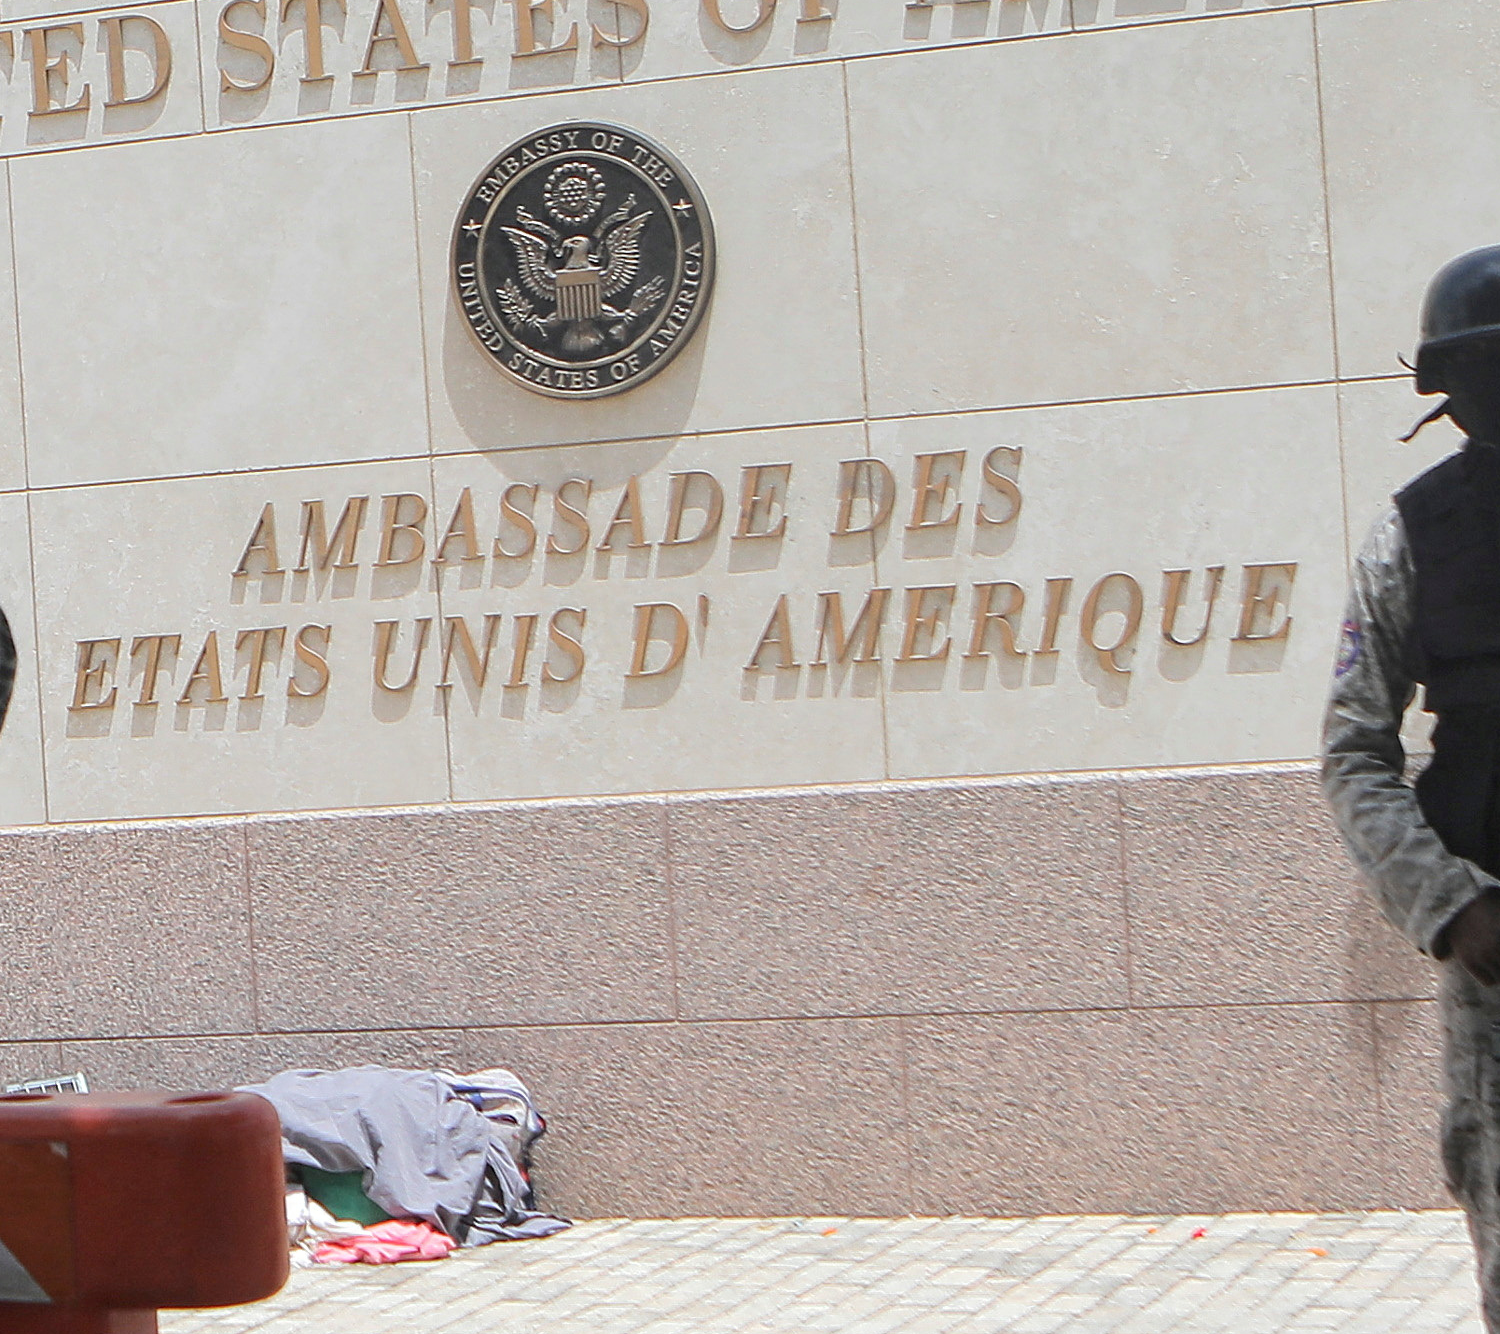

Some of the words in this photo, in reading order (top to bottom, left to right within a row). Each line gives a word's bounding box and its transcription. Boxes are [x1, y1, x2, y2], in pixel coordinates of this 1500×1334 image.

[476, 131, 580, 203] EMBASSY
[591, 132, 624, 153] OF
[632, 145, 675, 188] THE
[458, 262, 503, 353] UNITED
[508, 353, 598, 388] STATES
[610, 354, 640, 380] OF
[652, 241, 702, 356] AMERICA
[231, 461, 792, 576] AMBASSADE
[829, 445, 1024, 537] DES
[67, 623, 332, 711] ETATS
[372, 607, 586, 693] UNIS
[625, 593, 709, 678] D'
[742, 561, 1297, 674] AMERIQUE
